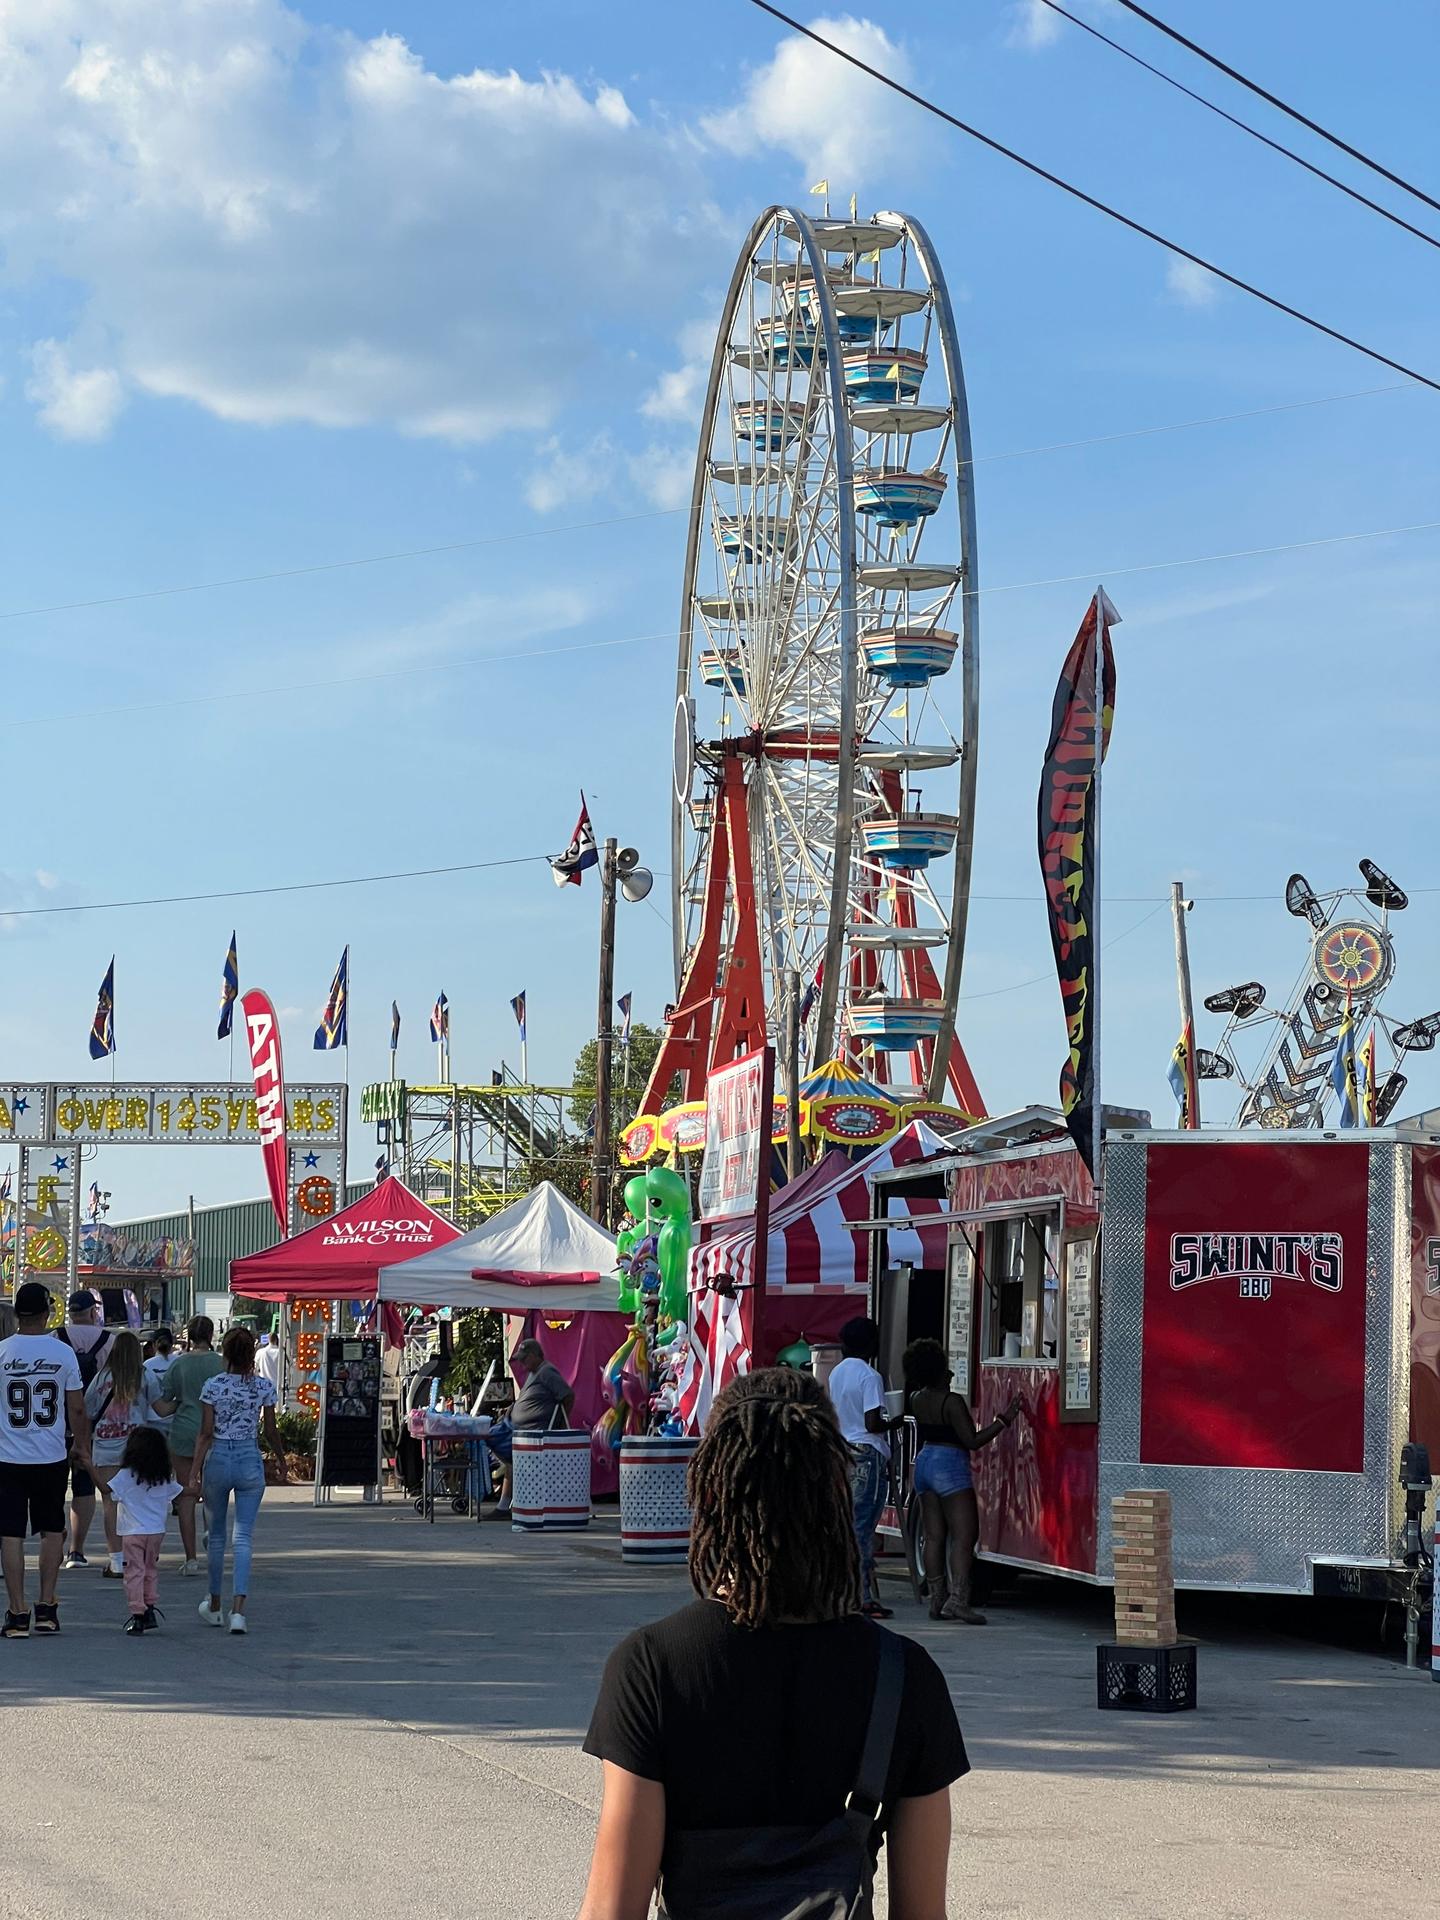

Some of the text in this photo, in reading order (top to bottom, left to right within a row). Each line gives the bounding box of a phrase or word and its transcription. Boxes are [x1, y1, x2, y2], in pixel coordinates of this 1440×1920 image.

[247, 1013, 283, 1146] ATM
[58, 1097, 335, 1131] OVER 125 YERS
[322, 1230, 434, 1246] Bank & Trust
[331, 1219, 434, 1236] WILSON
[1170, 1232, 1343, 1292] SWINT'S
[291, 1175, 333, 1420] GMES
[1239, 1277, 1272, 1301] BBQ
[7, 1379, 59, 1428] 93
